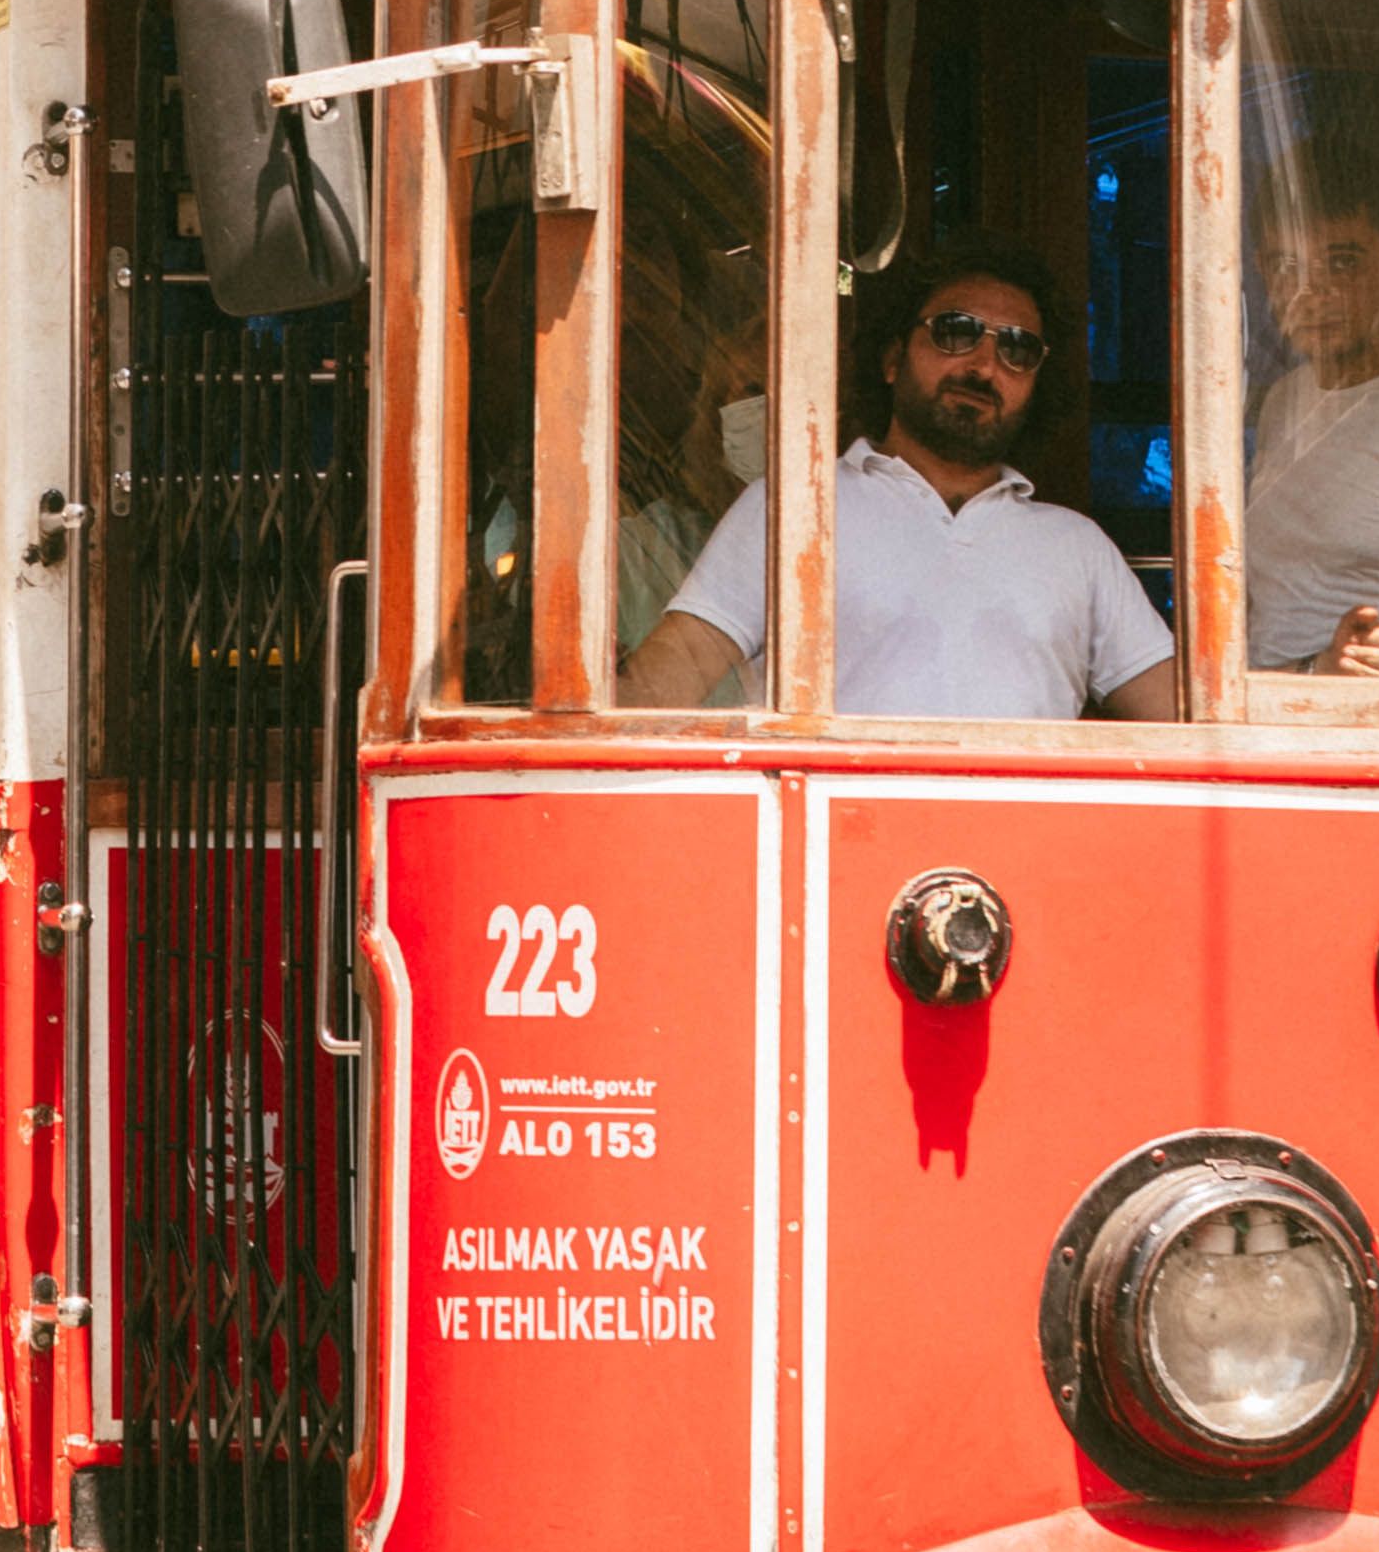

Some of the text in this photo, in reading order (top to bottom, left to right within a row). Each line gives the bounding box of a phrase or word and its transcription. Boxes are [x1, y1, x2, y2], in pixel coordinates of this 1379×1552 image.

[485, 904, 597, 1018] 223
[499, 1075, 657, 1100] www.iett.gov.tr
[498, 1120, 657, 1159] ALO 153
[441, 1226, 707, 1272] ASILMAK YASAK
[436, 1286, 716, 1341] VE TEHLİKELİDİR
